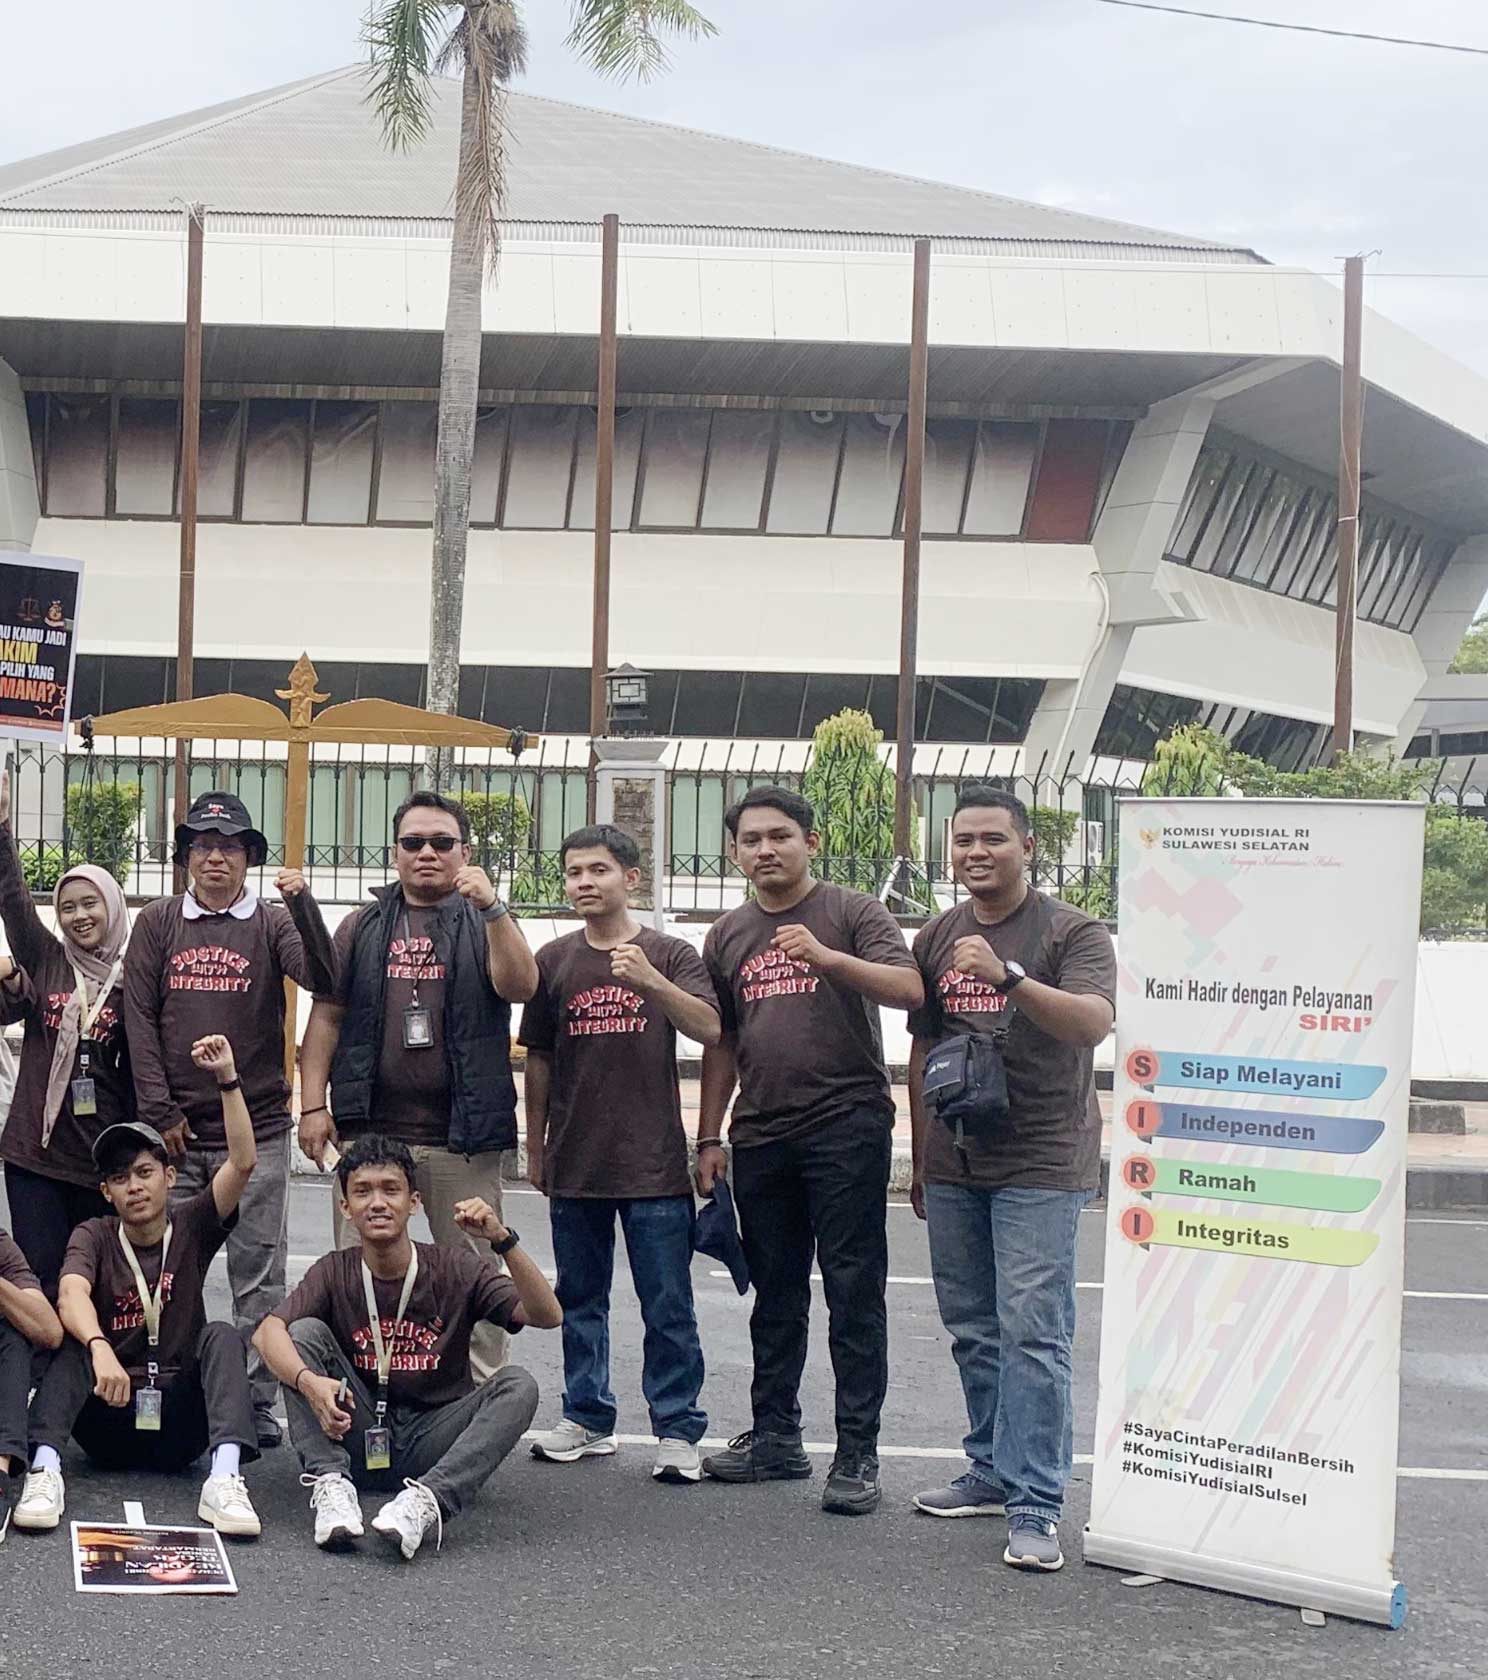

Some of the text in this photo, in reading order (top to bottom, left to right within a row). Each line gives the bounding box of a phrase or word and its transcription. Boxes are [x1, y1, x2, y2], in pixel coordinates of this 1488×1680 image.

[12, 626, 44, 643] KAMU
[44, 630, 67, 646] JADI
[0, 662, 26, 678] PILIH
[27, 665, 55, 681] YANG
[1162, 841, 1308, 850] SULAWESI SELATAN
[1163, 828, 1308, 837] KOMISI YUDISIAL RI
[171, 945, 250, 974] JUSTICE
[191, 963, 228, 976] WITH
[759, 965, 795, 981] WITH
[168, 975, 252, 993] INTEGRITY
[742, 976, 820, 1003] INTEGRITY
[1146, 978, 1372, 1014] Kami Hadir dengan Pelayanan
[567, 985, 645, 1017] JUSTICE
[587, 1004, 623, 1018] WITH
[568, 1017, 648, 1036] INTEGRITY
[1134, 1055, 1340, 1089] S Siap Melayani
[1137, 1107, 1315, 1140] I Independen
[1131, 1162, 1256, 1192] R Ramah
[1134, 1214, 1289, 1249] I Integritas
[1123, 1441, 1271, 1479] #KomisiYudisialRI
[1124, 1421, 1353, 1473] #SayaCintaPeradilanBersih
[1122, 1460, 1306, 1506] #KomisiYudisialSulsel
